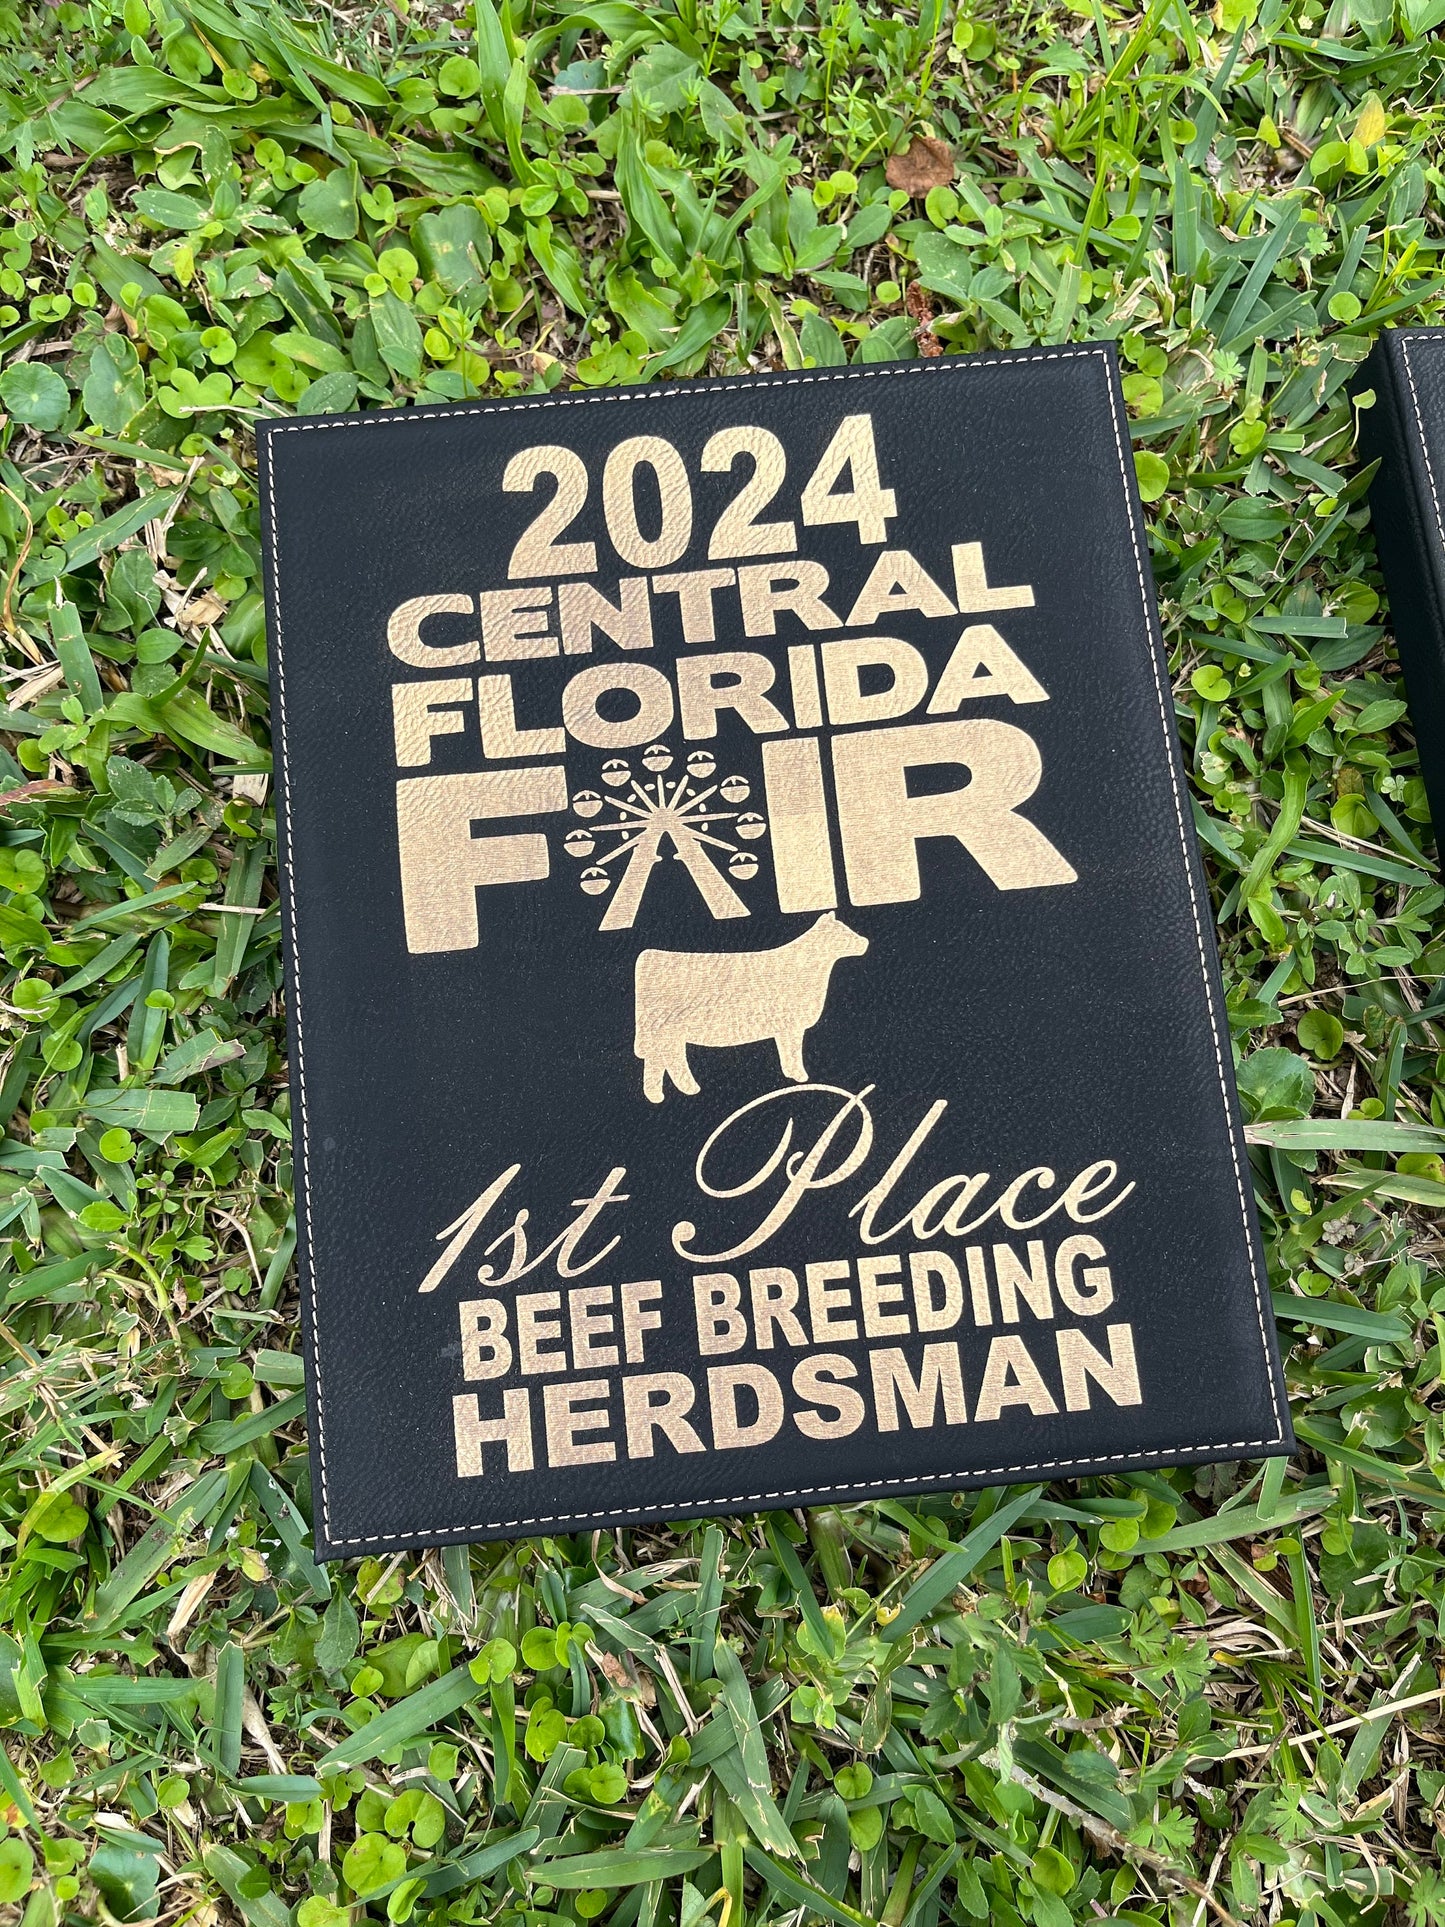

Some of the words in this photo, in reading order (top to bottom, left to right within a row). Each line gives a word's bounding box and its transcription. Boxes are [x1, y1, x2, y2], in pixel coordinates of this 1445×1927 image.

[501, 413, 899, 581] 2024
[387, 541, 1036, 669] CENTRAL
[391, 624, 1051, 768] FLORIDA
[395, 718, 1079, 955] FAIR
[417, 1163, 631, 1294] 1st
[671, 1083, 1137, 1264] Place
[458, 1279, 663, 1382] BEEF
[692, 1234, 1116, 1356] BREEDING
[452, 1323, 1143, 1479] HERDSMAN
